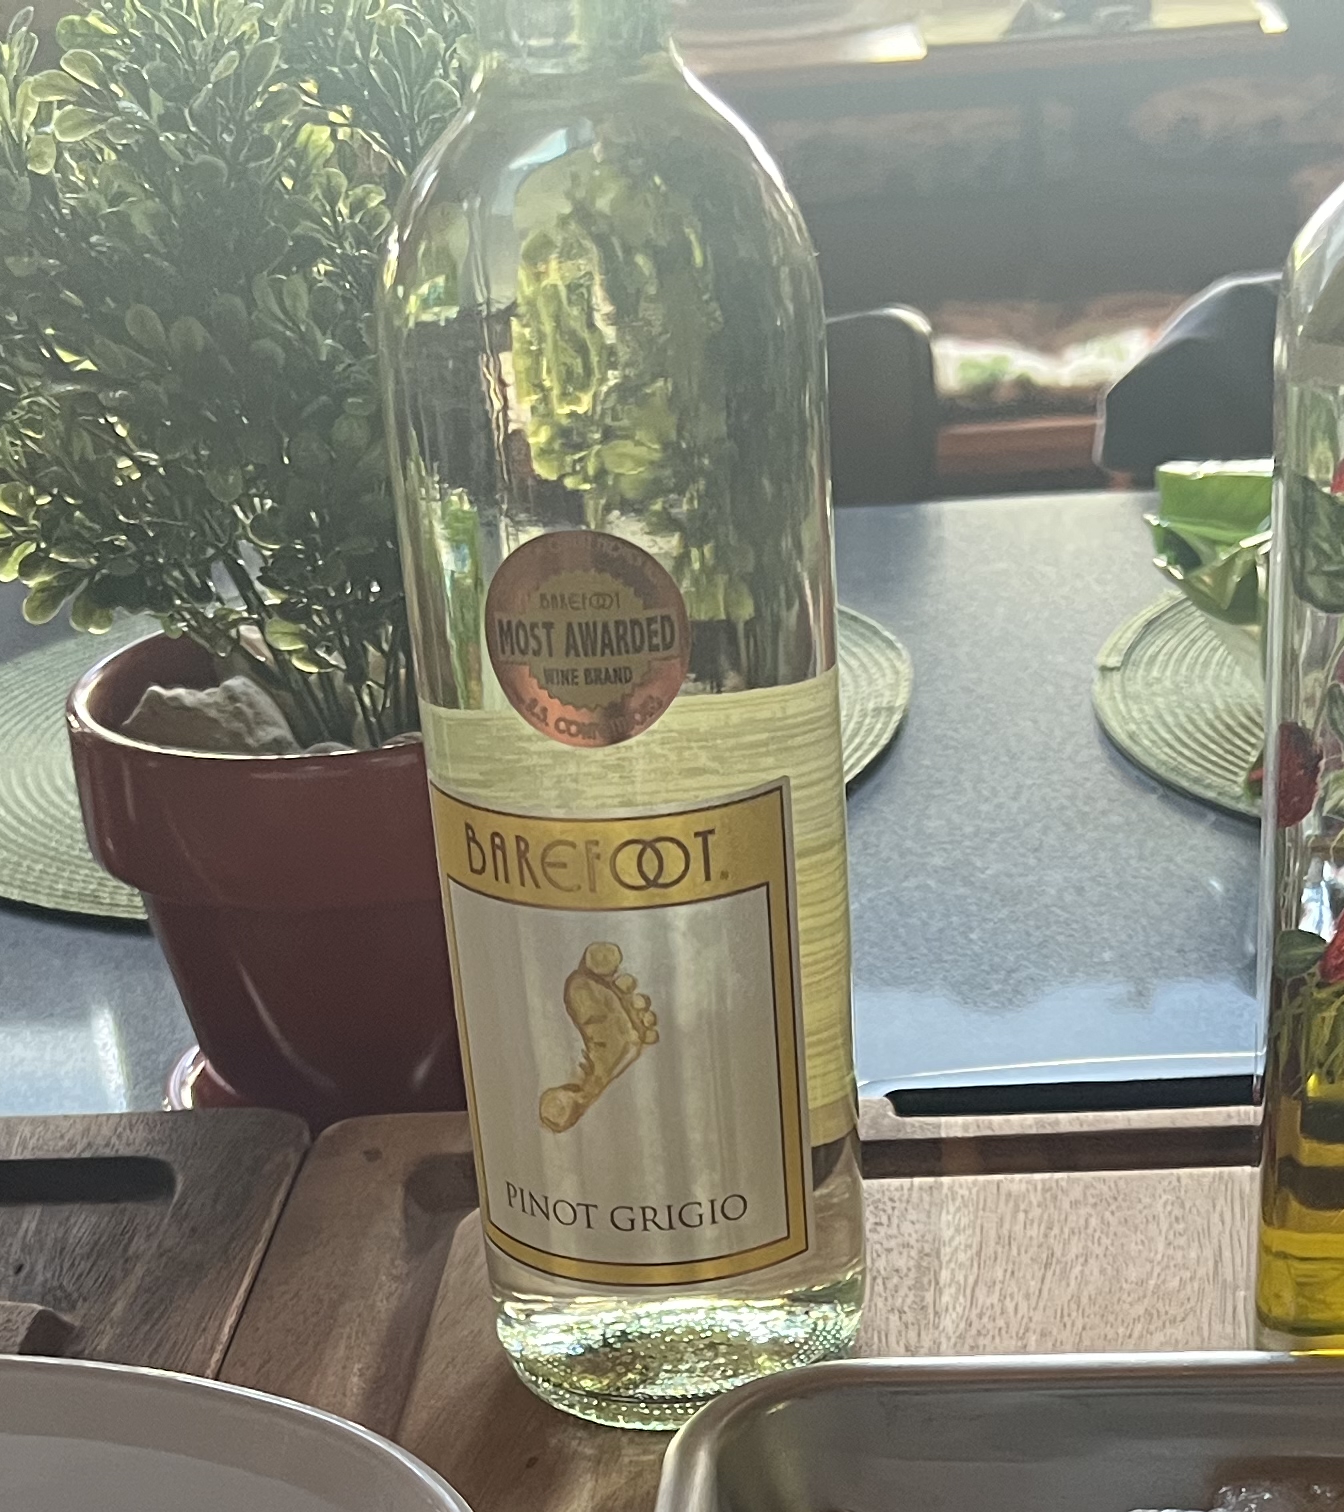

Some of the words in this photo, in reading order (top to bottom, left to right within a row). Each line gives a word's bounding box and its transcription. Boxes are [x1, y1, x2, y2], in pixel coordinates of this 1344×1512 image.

[497, 618, 555, 658] MOST
[565, 613, 676, 658] AWARDED
[542, 666, 580, 686] WINE
[583, 665, 634, 687] BRAND
[464, 820, 716, 894] BAREFOOT
[504, 1180, 599, 1231] PINOT
[609, 1193, 749, 1233] GRIGIO
